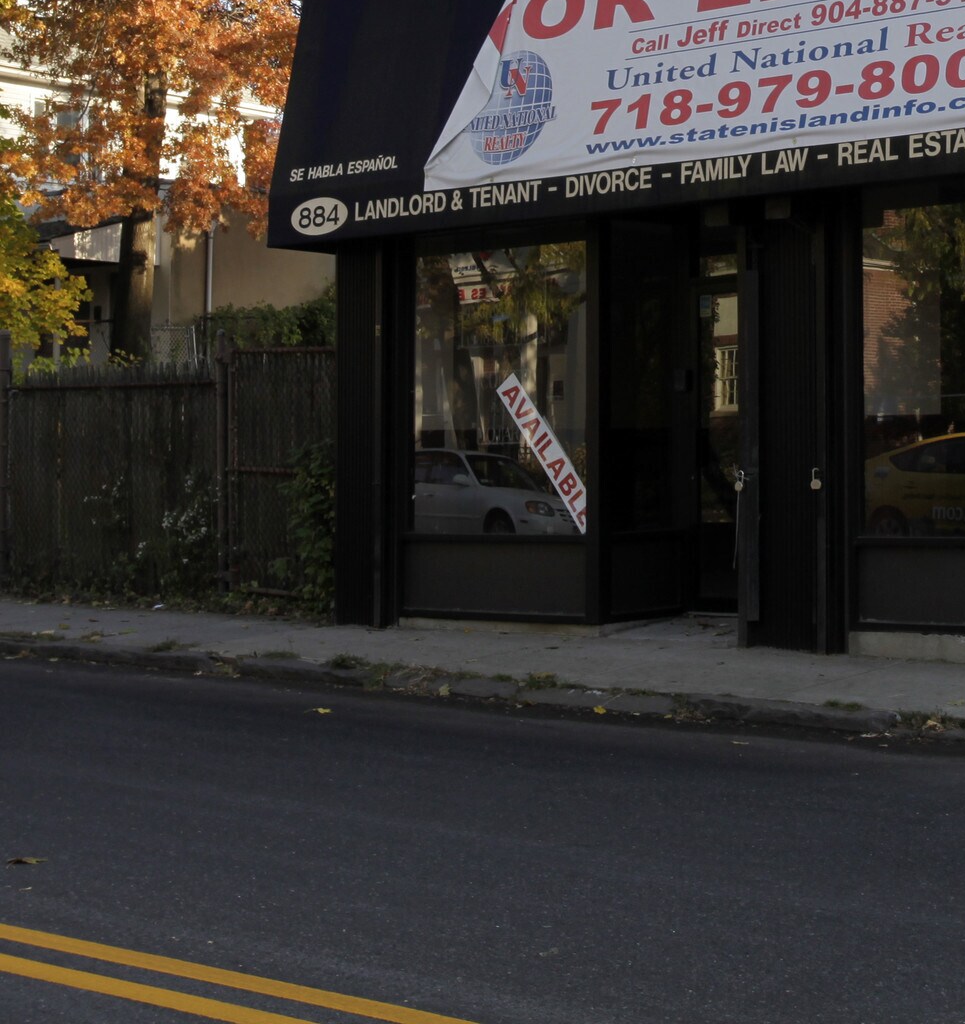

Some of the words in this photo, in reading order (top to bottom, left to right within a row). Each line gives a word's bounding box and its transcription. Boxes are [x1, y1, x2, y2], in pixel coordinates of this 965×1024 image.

[632, 34, 669, 54] Call
[677, 20, 729, 47] Jeff
[737, 13, 801, 38] Direct
[607, 53, 717, 90] United
[729, 26, 888, 73] National
[502, 106, 557, 127] NATIONAL
[484, 132, 525, 151] REALTY
[289, 168, 304, 182] SE
[308, 163, 343, 180] HABLA
[347, 155, 398, 174] ESPAÑOL
[355, 192, 446, 222] LANDLORD
[451, 192, 463, 211] &
[469, 180, 542, 209] TENANT
[565, 166, 653, 198] DIVORCE
[680, 154, 751, 185] FAMILY
[761, 148, 809, 175] LAW
[838, 138, 898, 166] REAL
[298, 203, 340, 229] 884
